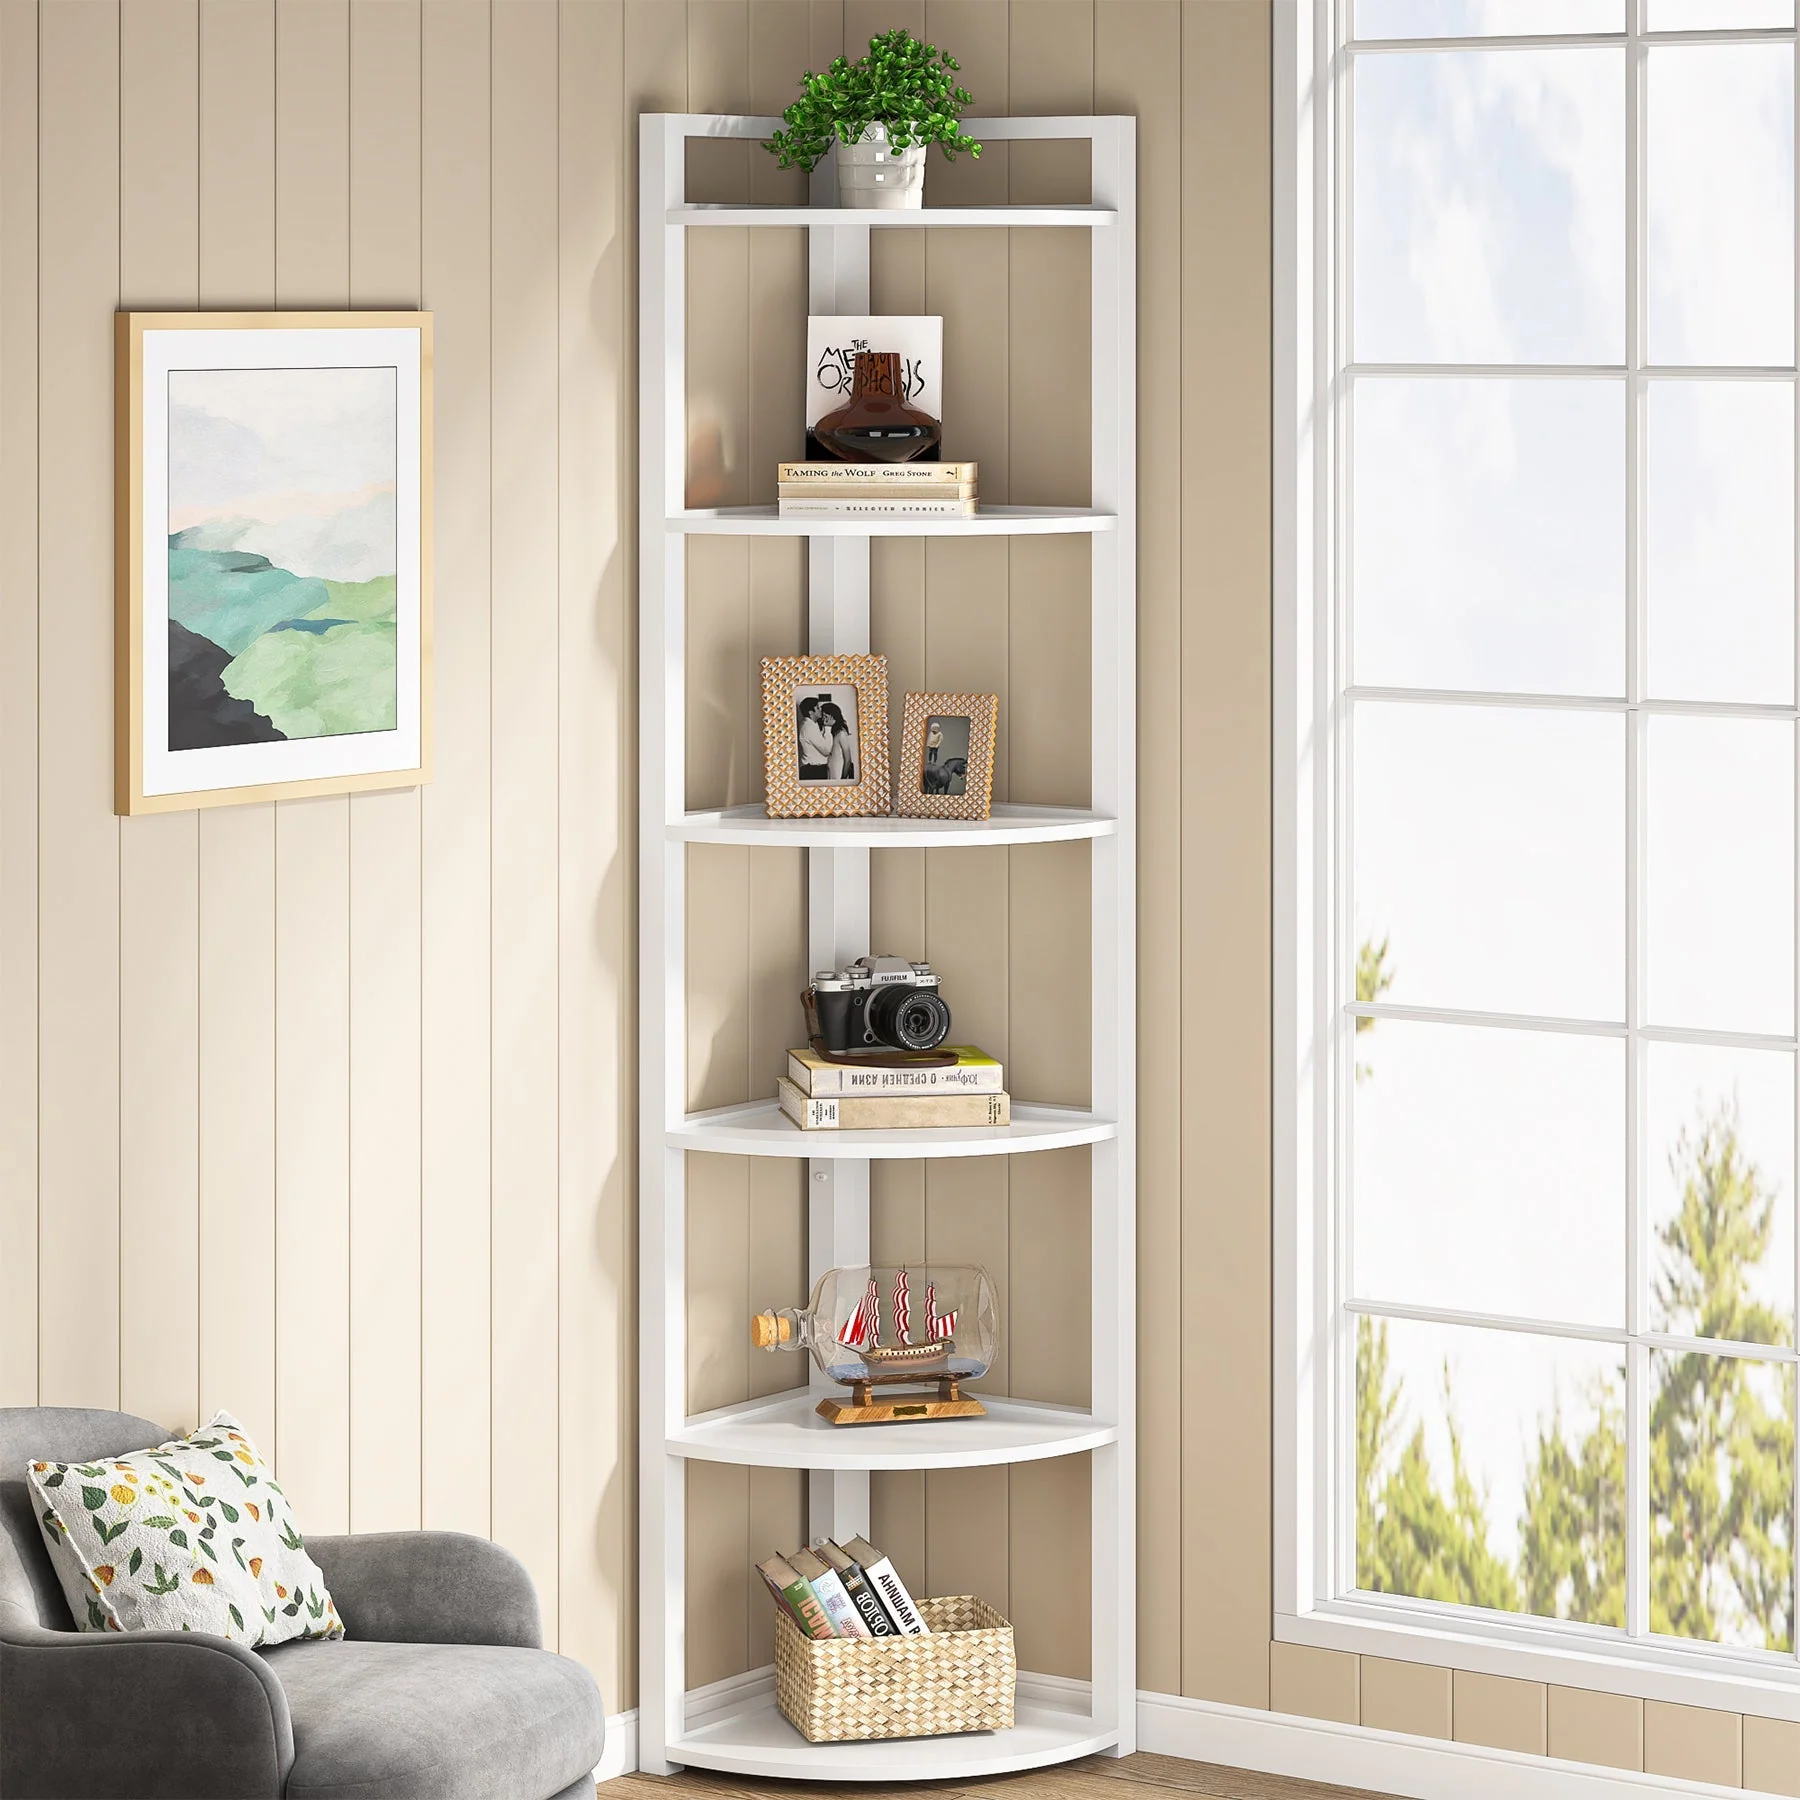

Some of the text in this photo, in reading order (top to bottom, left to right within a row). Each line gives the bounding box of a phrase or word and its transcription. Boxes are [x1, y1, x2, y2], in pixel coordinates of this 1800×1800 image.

[851, 339, 869, 351] THE
[784, 468, 932, 478] TAMING the WOLF GREG STONE
[851, 1074, 878, 1086] АЗИИ
[881, 1073, 927, 1088] СРЕДНЕЙ
[930, 1073, 937, 1084] О
